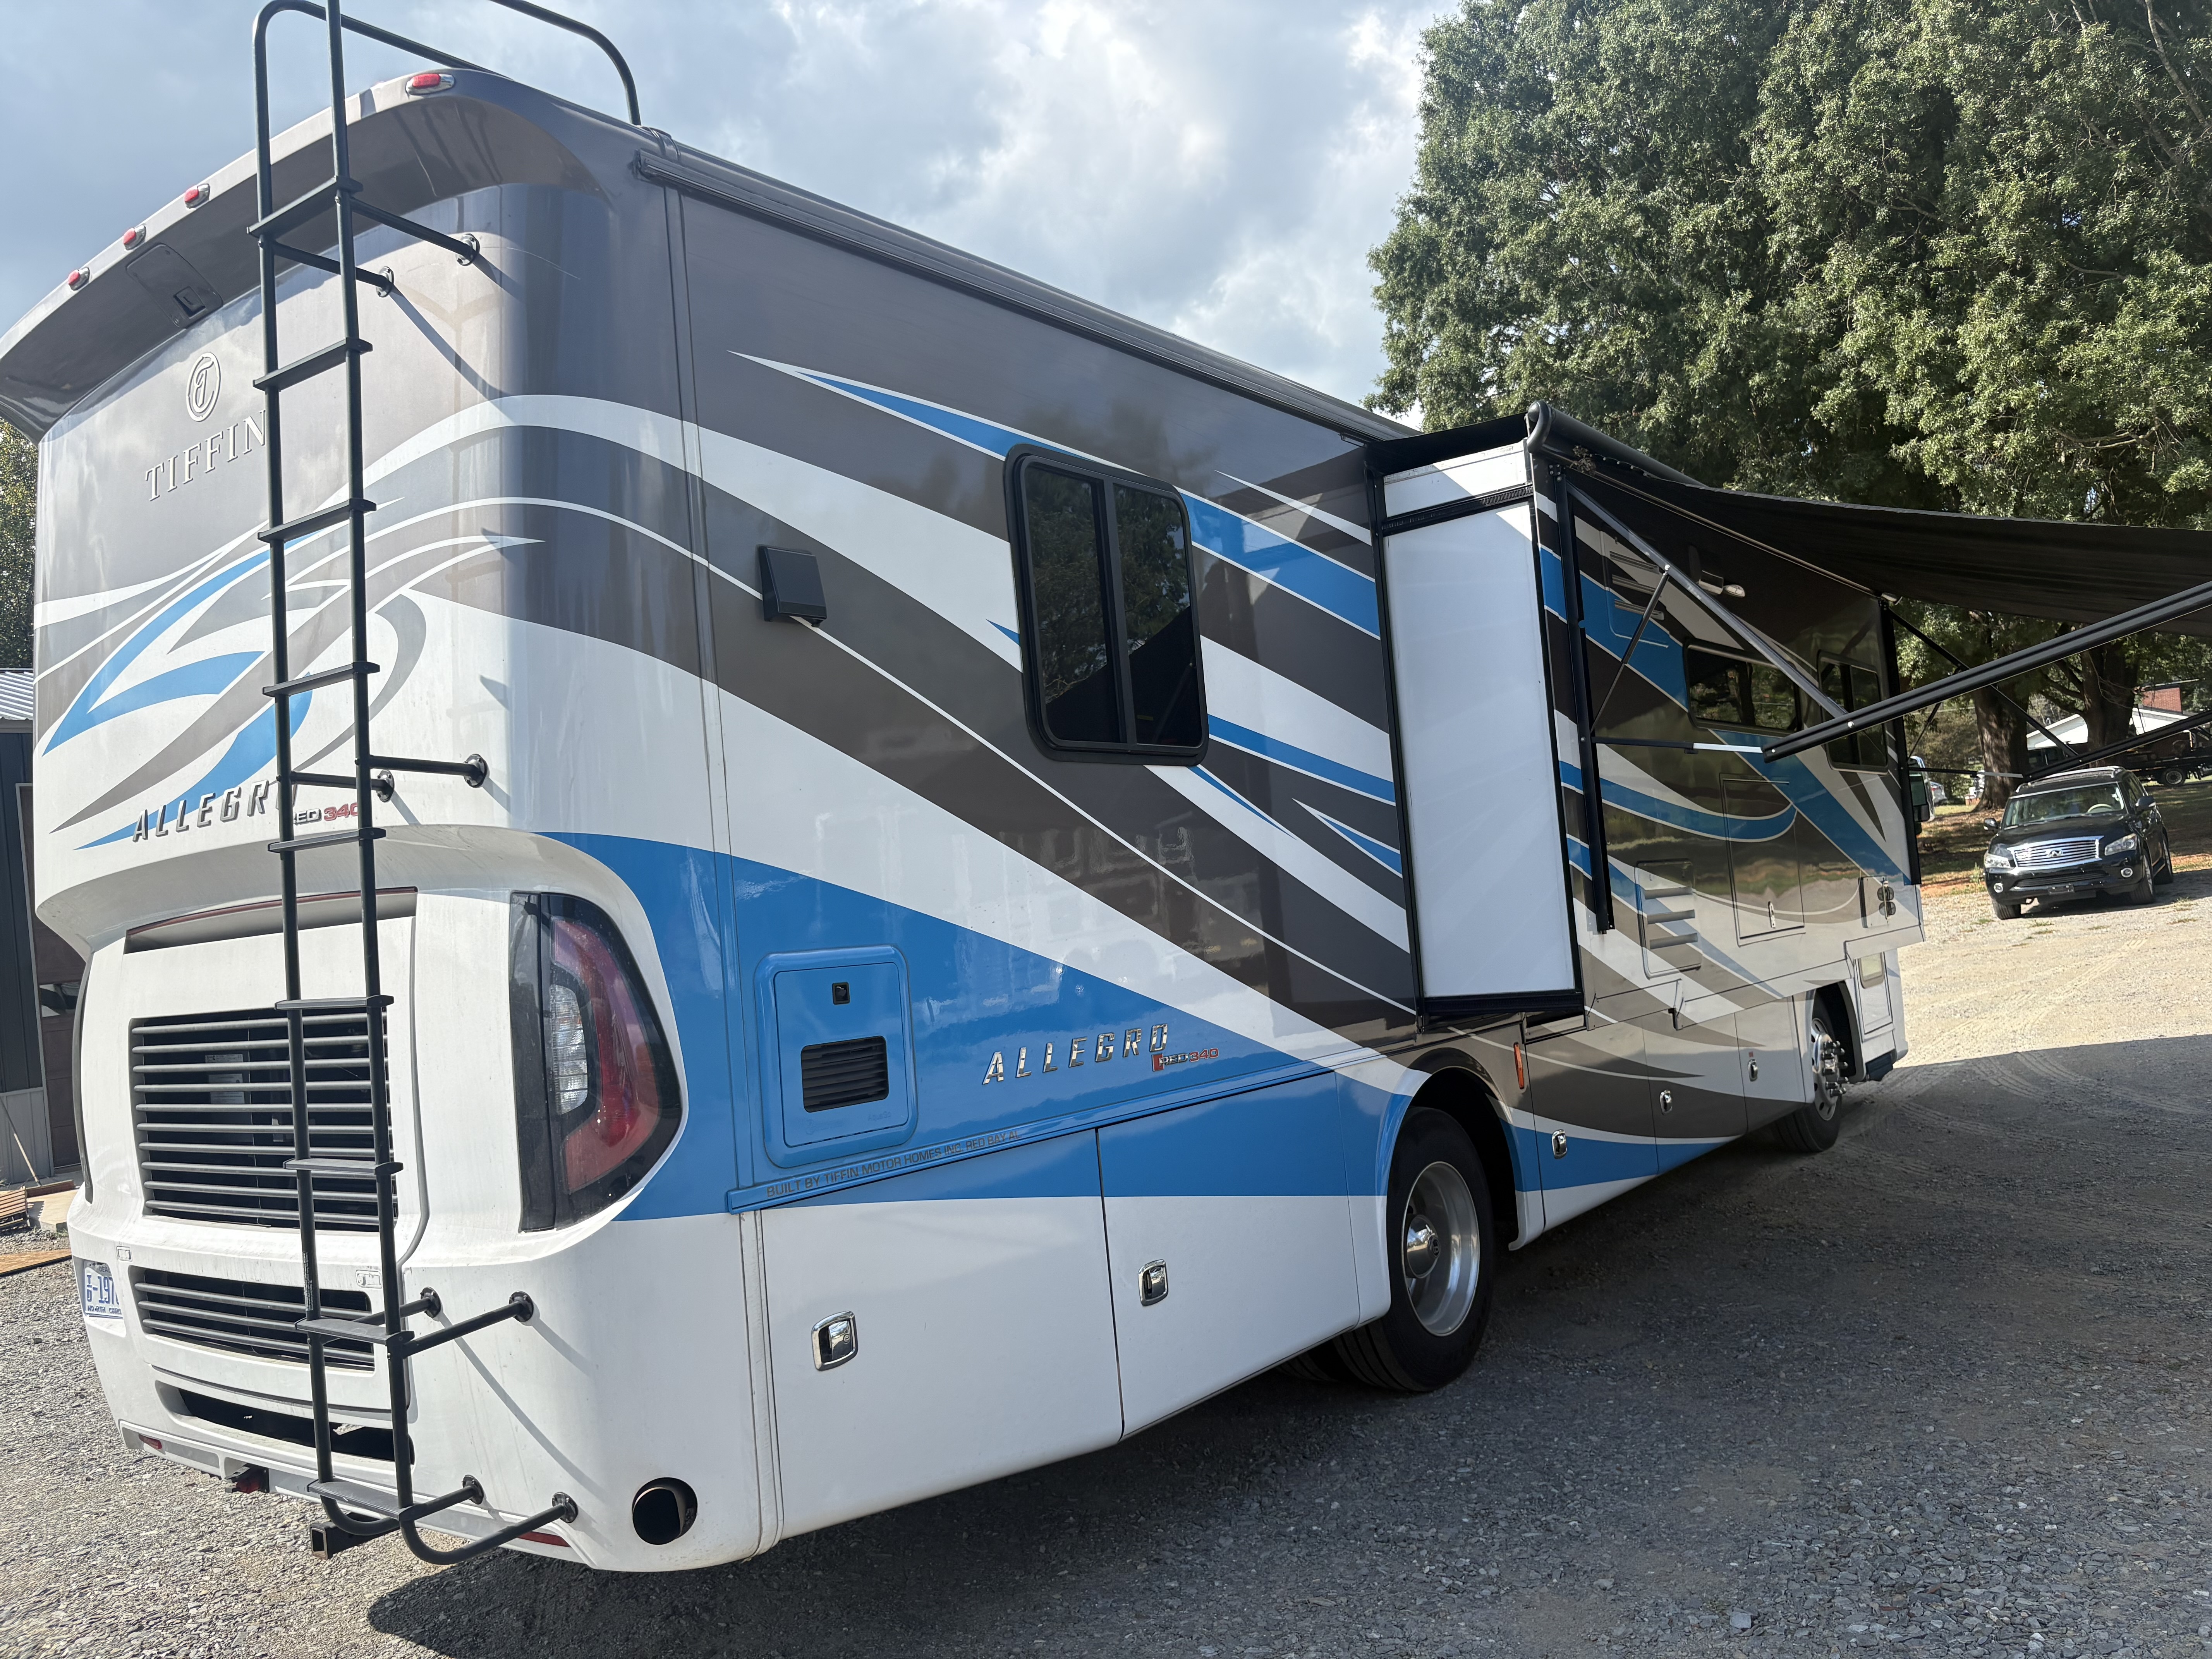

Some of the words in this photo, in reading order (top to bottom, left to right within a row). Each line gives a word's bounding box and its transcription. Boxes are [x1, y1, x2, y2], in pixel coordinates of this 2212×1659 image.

[145, 409, 266, 501] TIFFIN
[982, 1024, 1168, 1084] ALLEGRO
[1159, 1053, 1188, 1066] RED
[1189, 1048, 1219, 1062] 340
[766, 1180, 801, 1197] BUILT
[805, 1176, 820, 1188] BY
[824, 1167, 859, 1182] TIFFIN
[862, 1157, 902, 1175] MOTOR
[904, 1147, 941, 1165] HOMES
[944, 1142, 963, 1155] INC.
[966, 1137, 985, 1150] RED
[988, 1133, 1006, 1145] BAY
[88, 1305, 106, 1313] NORTH
